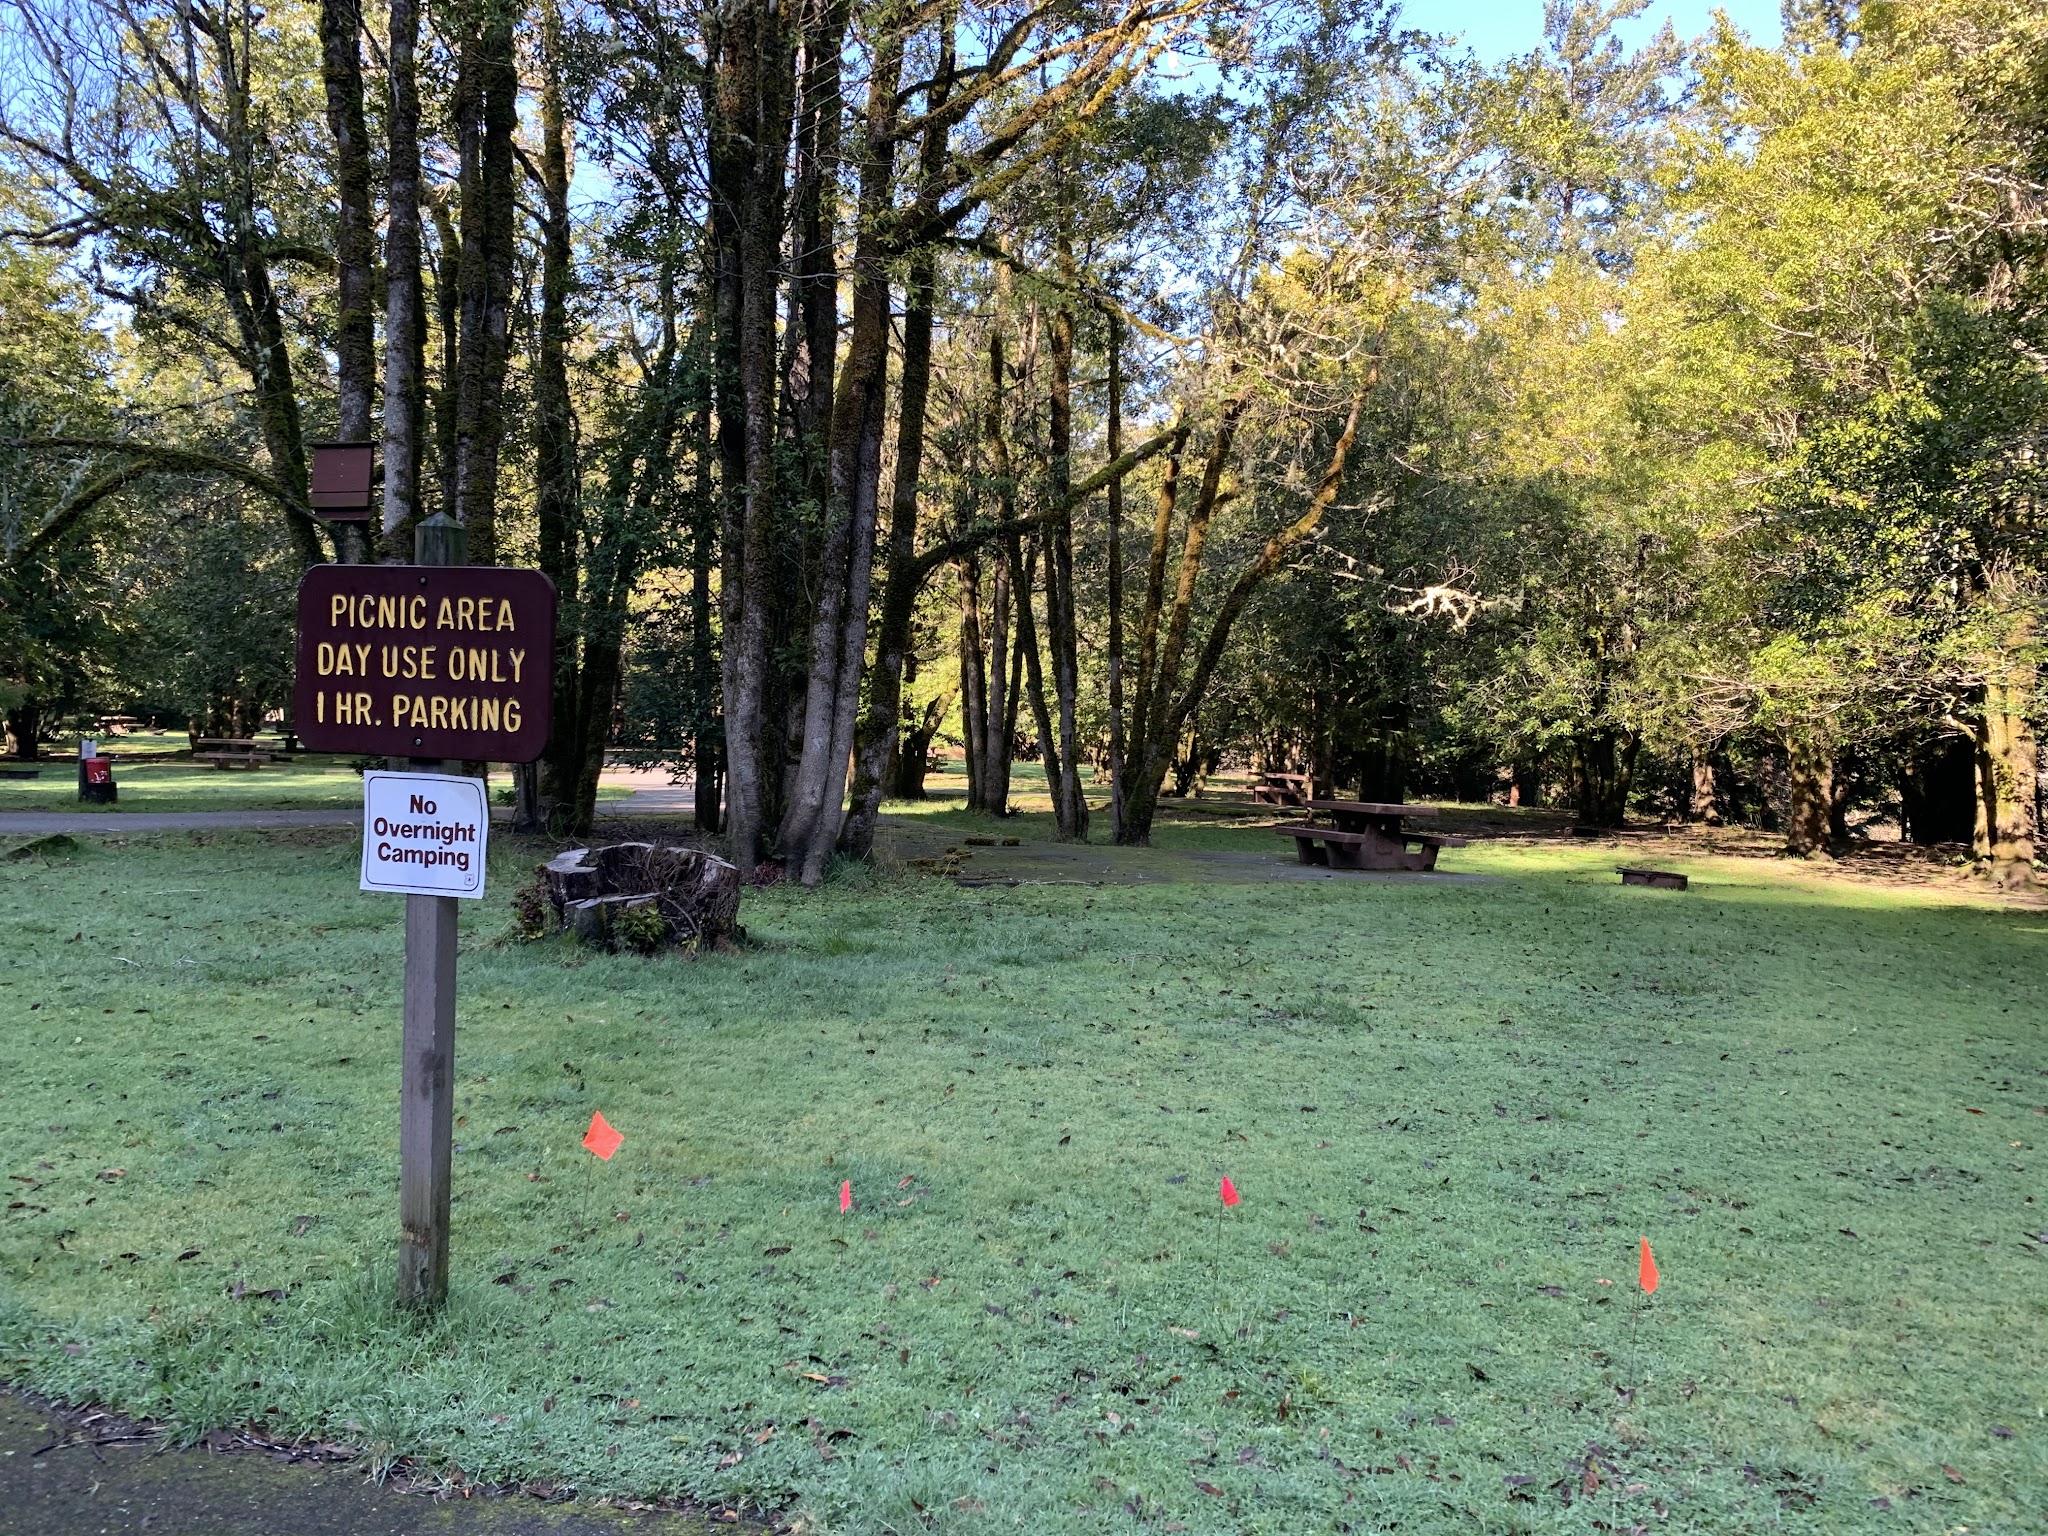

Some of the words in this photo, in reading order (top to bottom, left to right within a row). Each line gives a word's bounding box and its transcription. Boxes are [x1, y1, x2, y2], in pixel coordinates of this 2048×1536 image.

[331, 594, 427, 630] PICNIC
[436, 596, 515, 632] AREA
[317, 643, 371, 677] DAY
[382, 645, 436, 680] USE
[448, 646, 525, 684] ONLY
[335, 691, 382, 727] HR.
[392, 694, 522, 733] PARKING
[409, 794, 437, 815] No
[373, 817, 476, 846] Overnight
[377, 842, 470, 871] Camping
